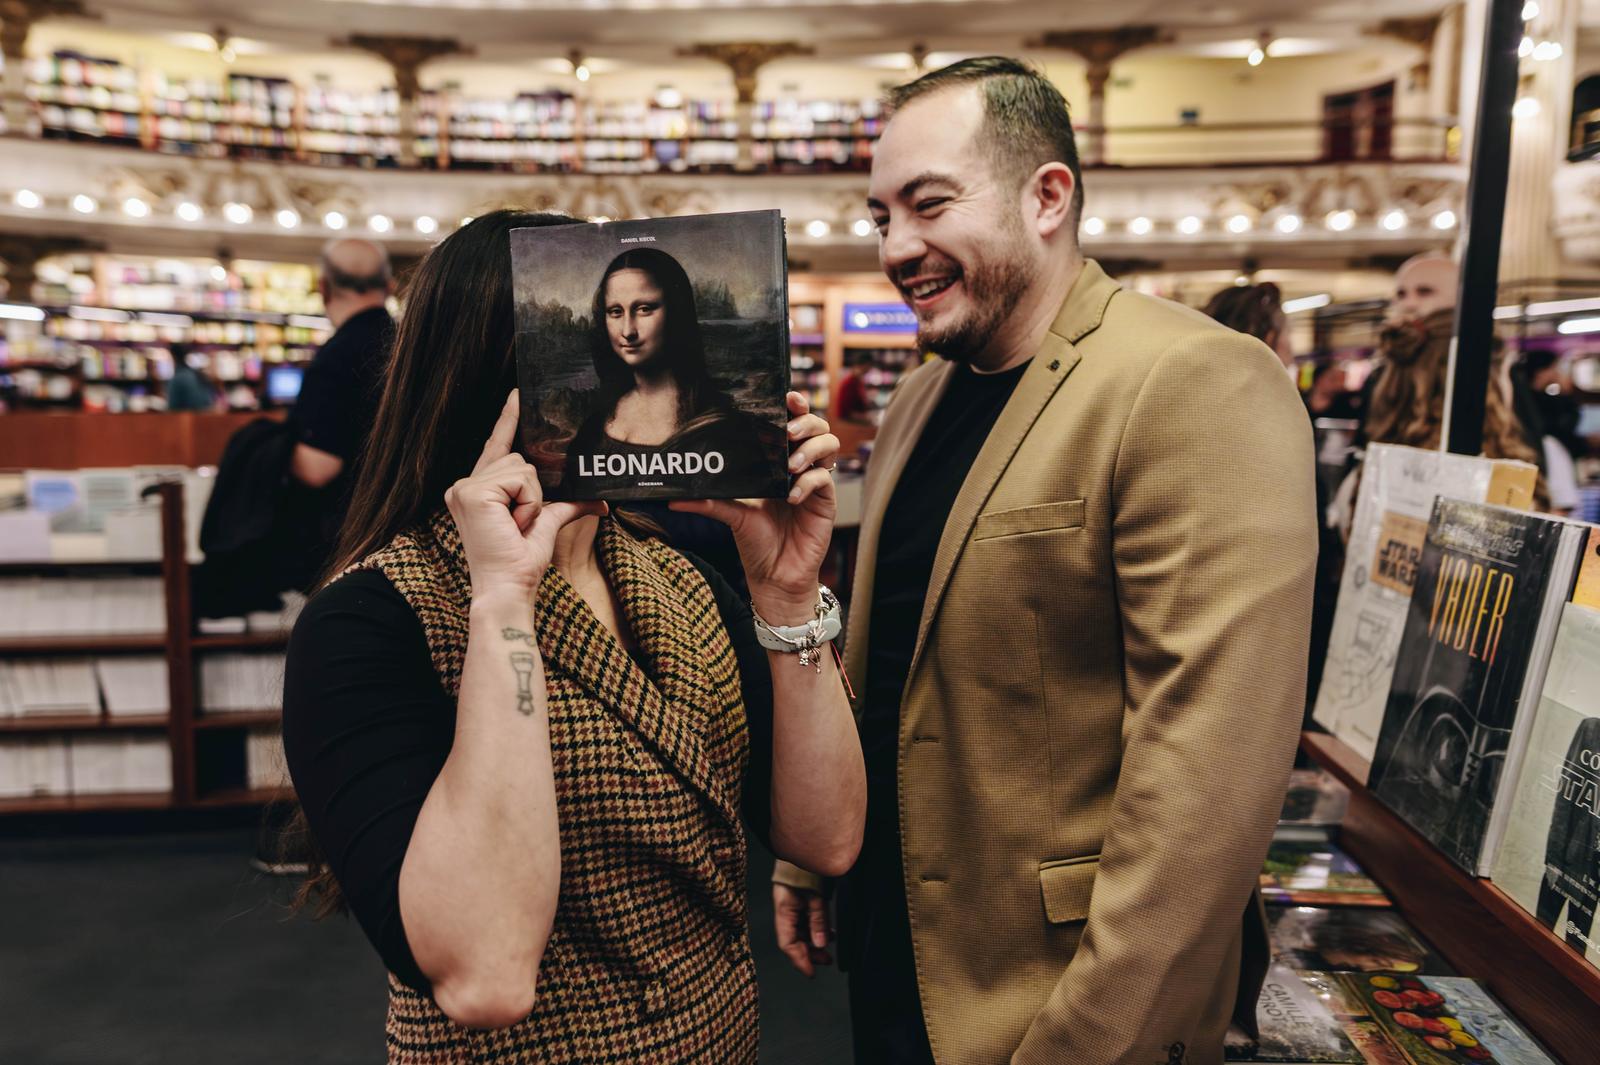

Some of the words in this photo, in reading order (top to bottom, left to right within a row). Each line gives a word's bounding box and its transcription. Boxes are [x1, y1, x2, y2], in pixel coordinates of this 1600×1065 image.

[578, 451, 725, 477] LEONARDO
[1380, 539, 1420, 564] STAR
[1427, 553, 1514, 666] VADER
[1260, 988, 1289, 1023] OROT
[1267, 983, 1313, 1028] CAMILLE
